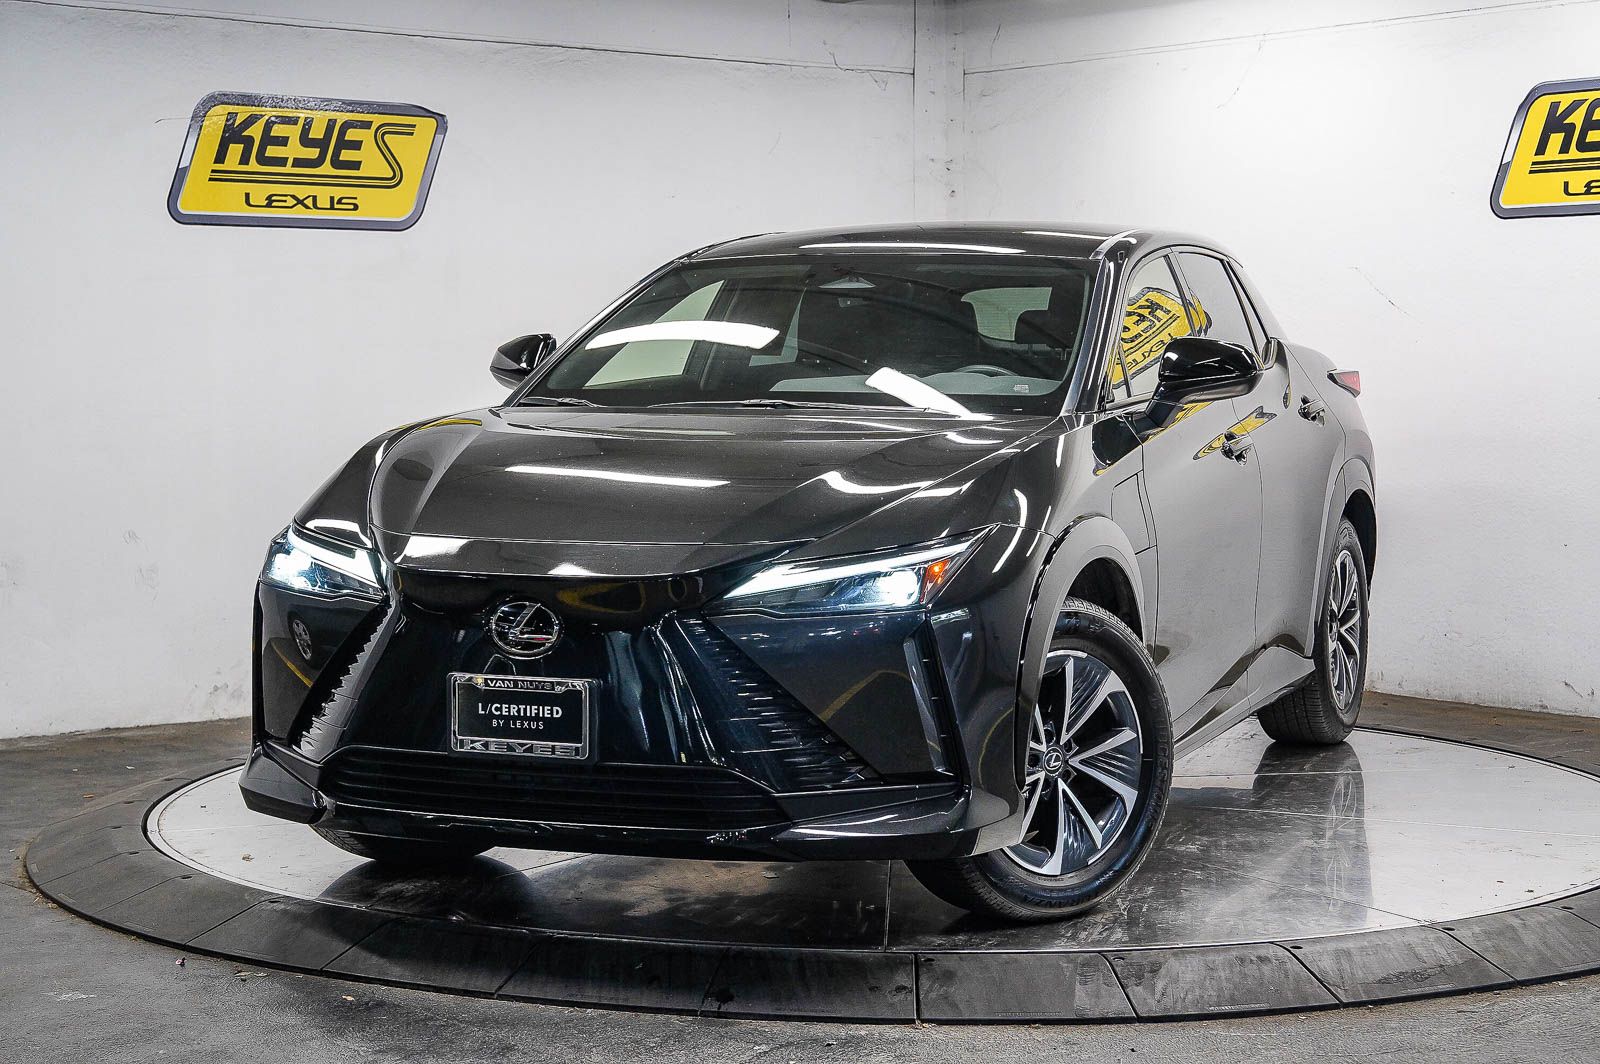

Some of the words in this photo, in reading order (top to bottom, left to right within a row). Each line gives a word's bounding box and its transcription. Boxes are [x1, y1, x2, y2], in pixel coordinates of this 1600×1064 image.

[208, 112, 416, 188] KEYES
[244, 192, 359, 211] LEXUS
[486, 679, 514, 688] VAN
[518, 680, 554, 690] NUYS
[478, 702, 563, 718] L/CERTIFIED
[492, 719, 505, 728] BY
[510, 720, 544, 730] LEXUS
[464, 739, 576, 757] KEYES
